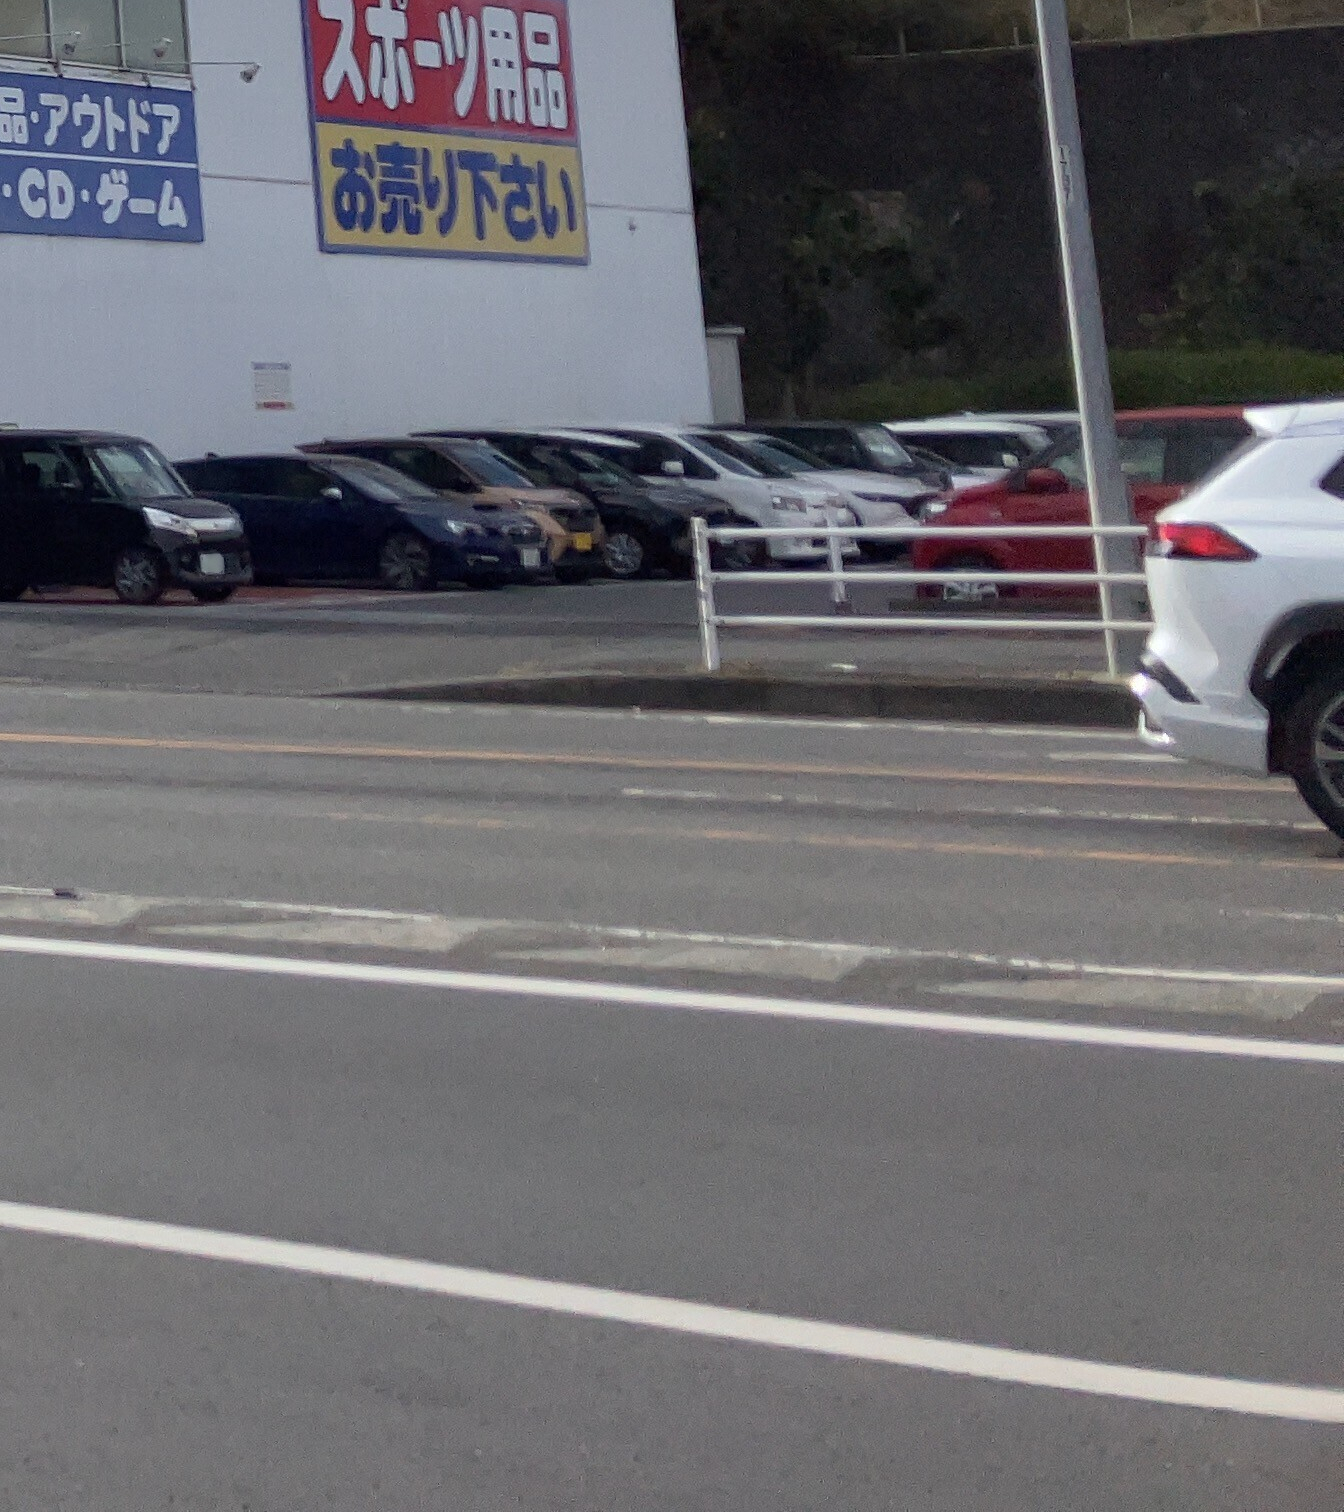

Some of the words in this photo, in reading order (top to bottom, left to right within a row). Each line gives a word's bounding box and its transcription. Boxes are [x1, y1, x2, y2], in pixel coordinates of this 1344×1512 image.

[330, 138, 579, 242] お売り下さい
